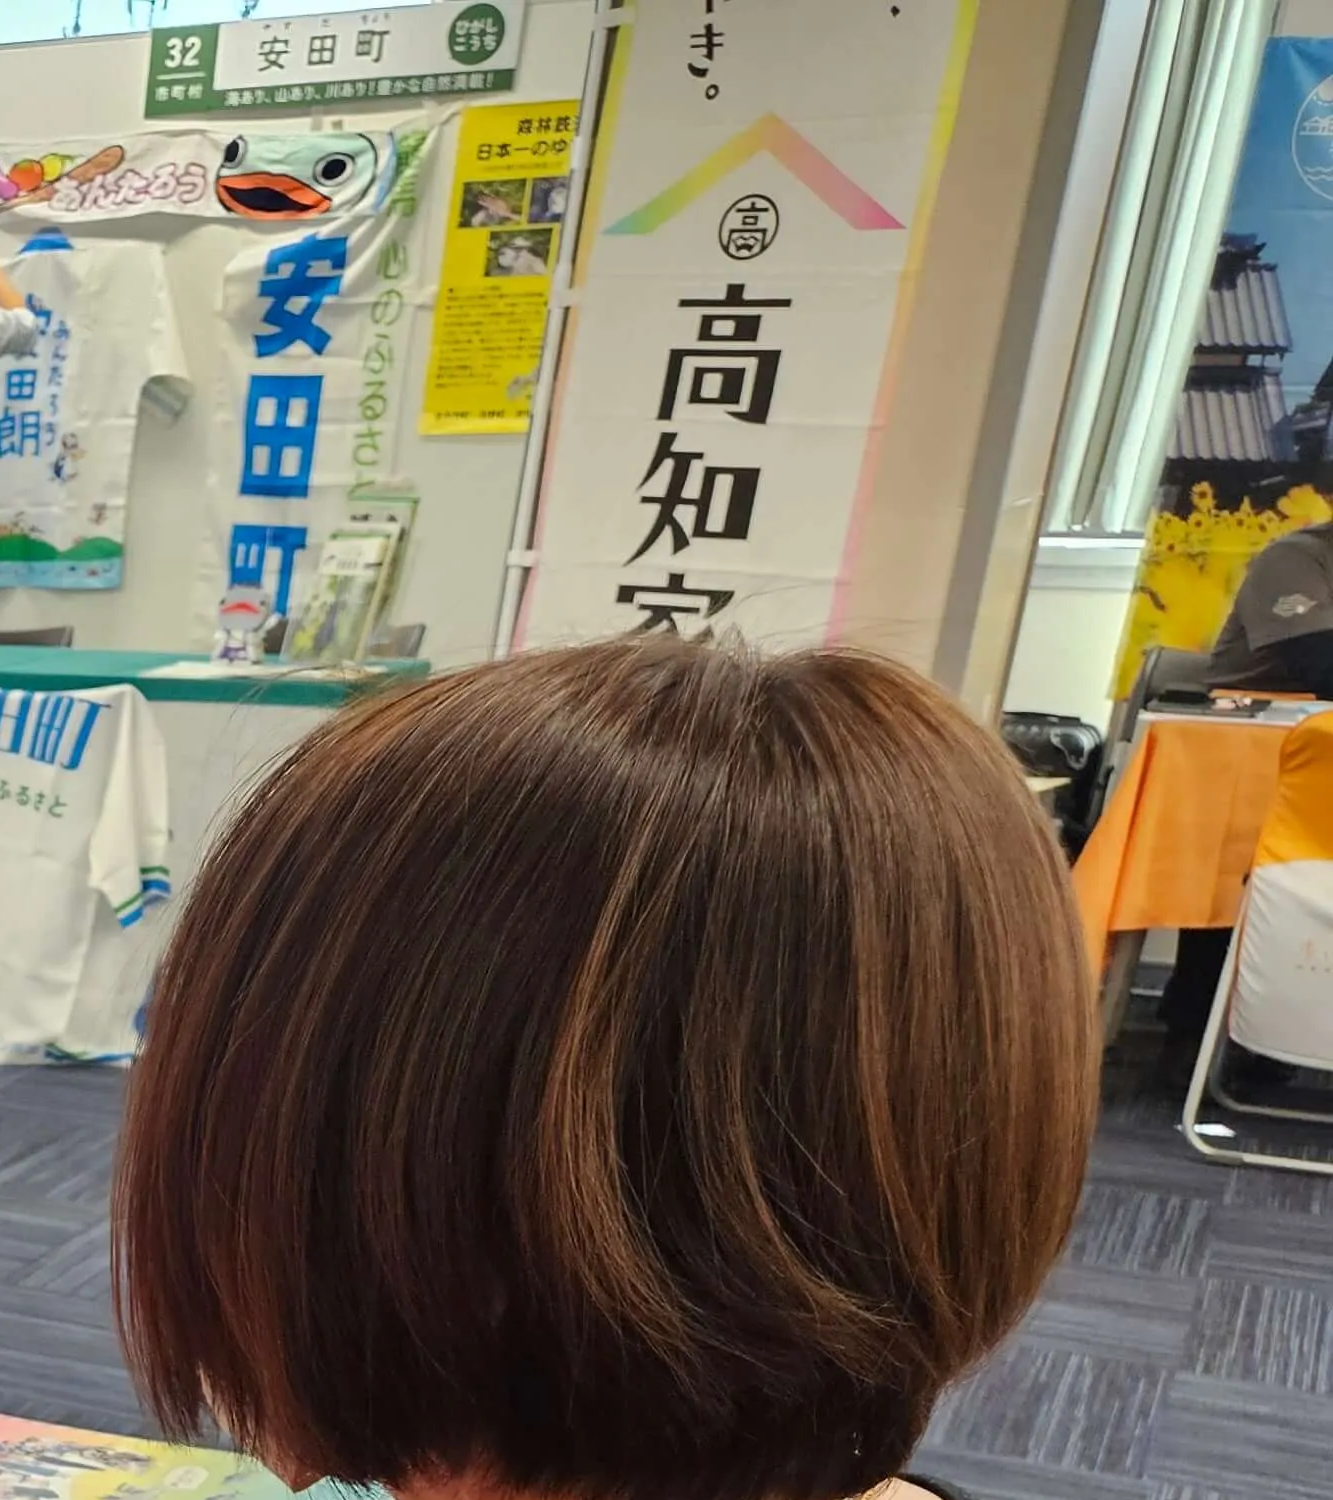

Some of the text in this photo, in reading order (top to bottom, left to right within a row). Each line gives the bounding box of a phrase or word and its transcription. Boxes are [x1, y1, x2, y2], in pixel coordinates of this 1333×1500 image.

[165, 36, 202, 67] 32
[258, 30, 390, 71] 安田町
[455, 36, 497, 52] こうち
[155, 84, 203, 101] 市町村
[48, 162, 208, 213] あんたろう
[229, 234, 348, 617] 安田町
[615, 283, 793, 645] 高知家
